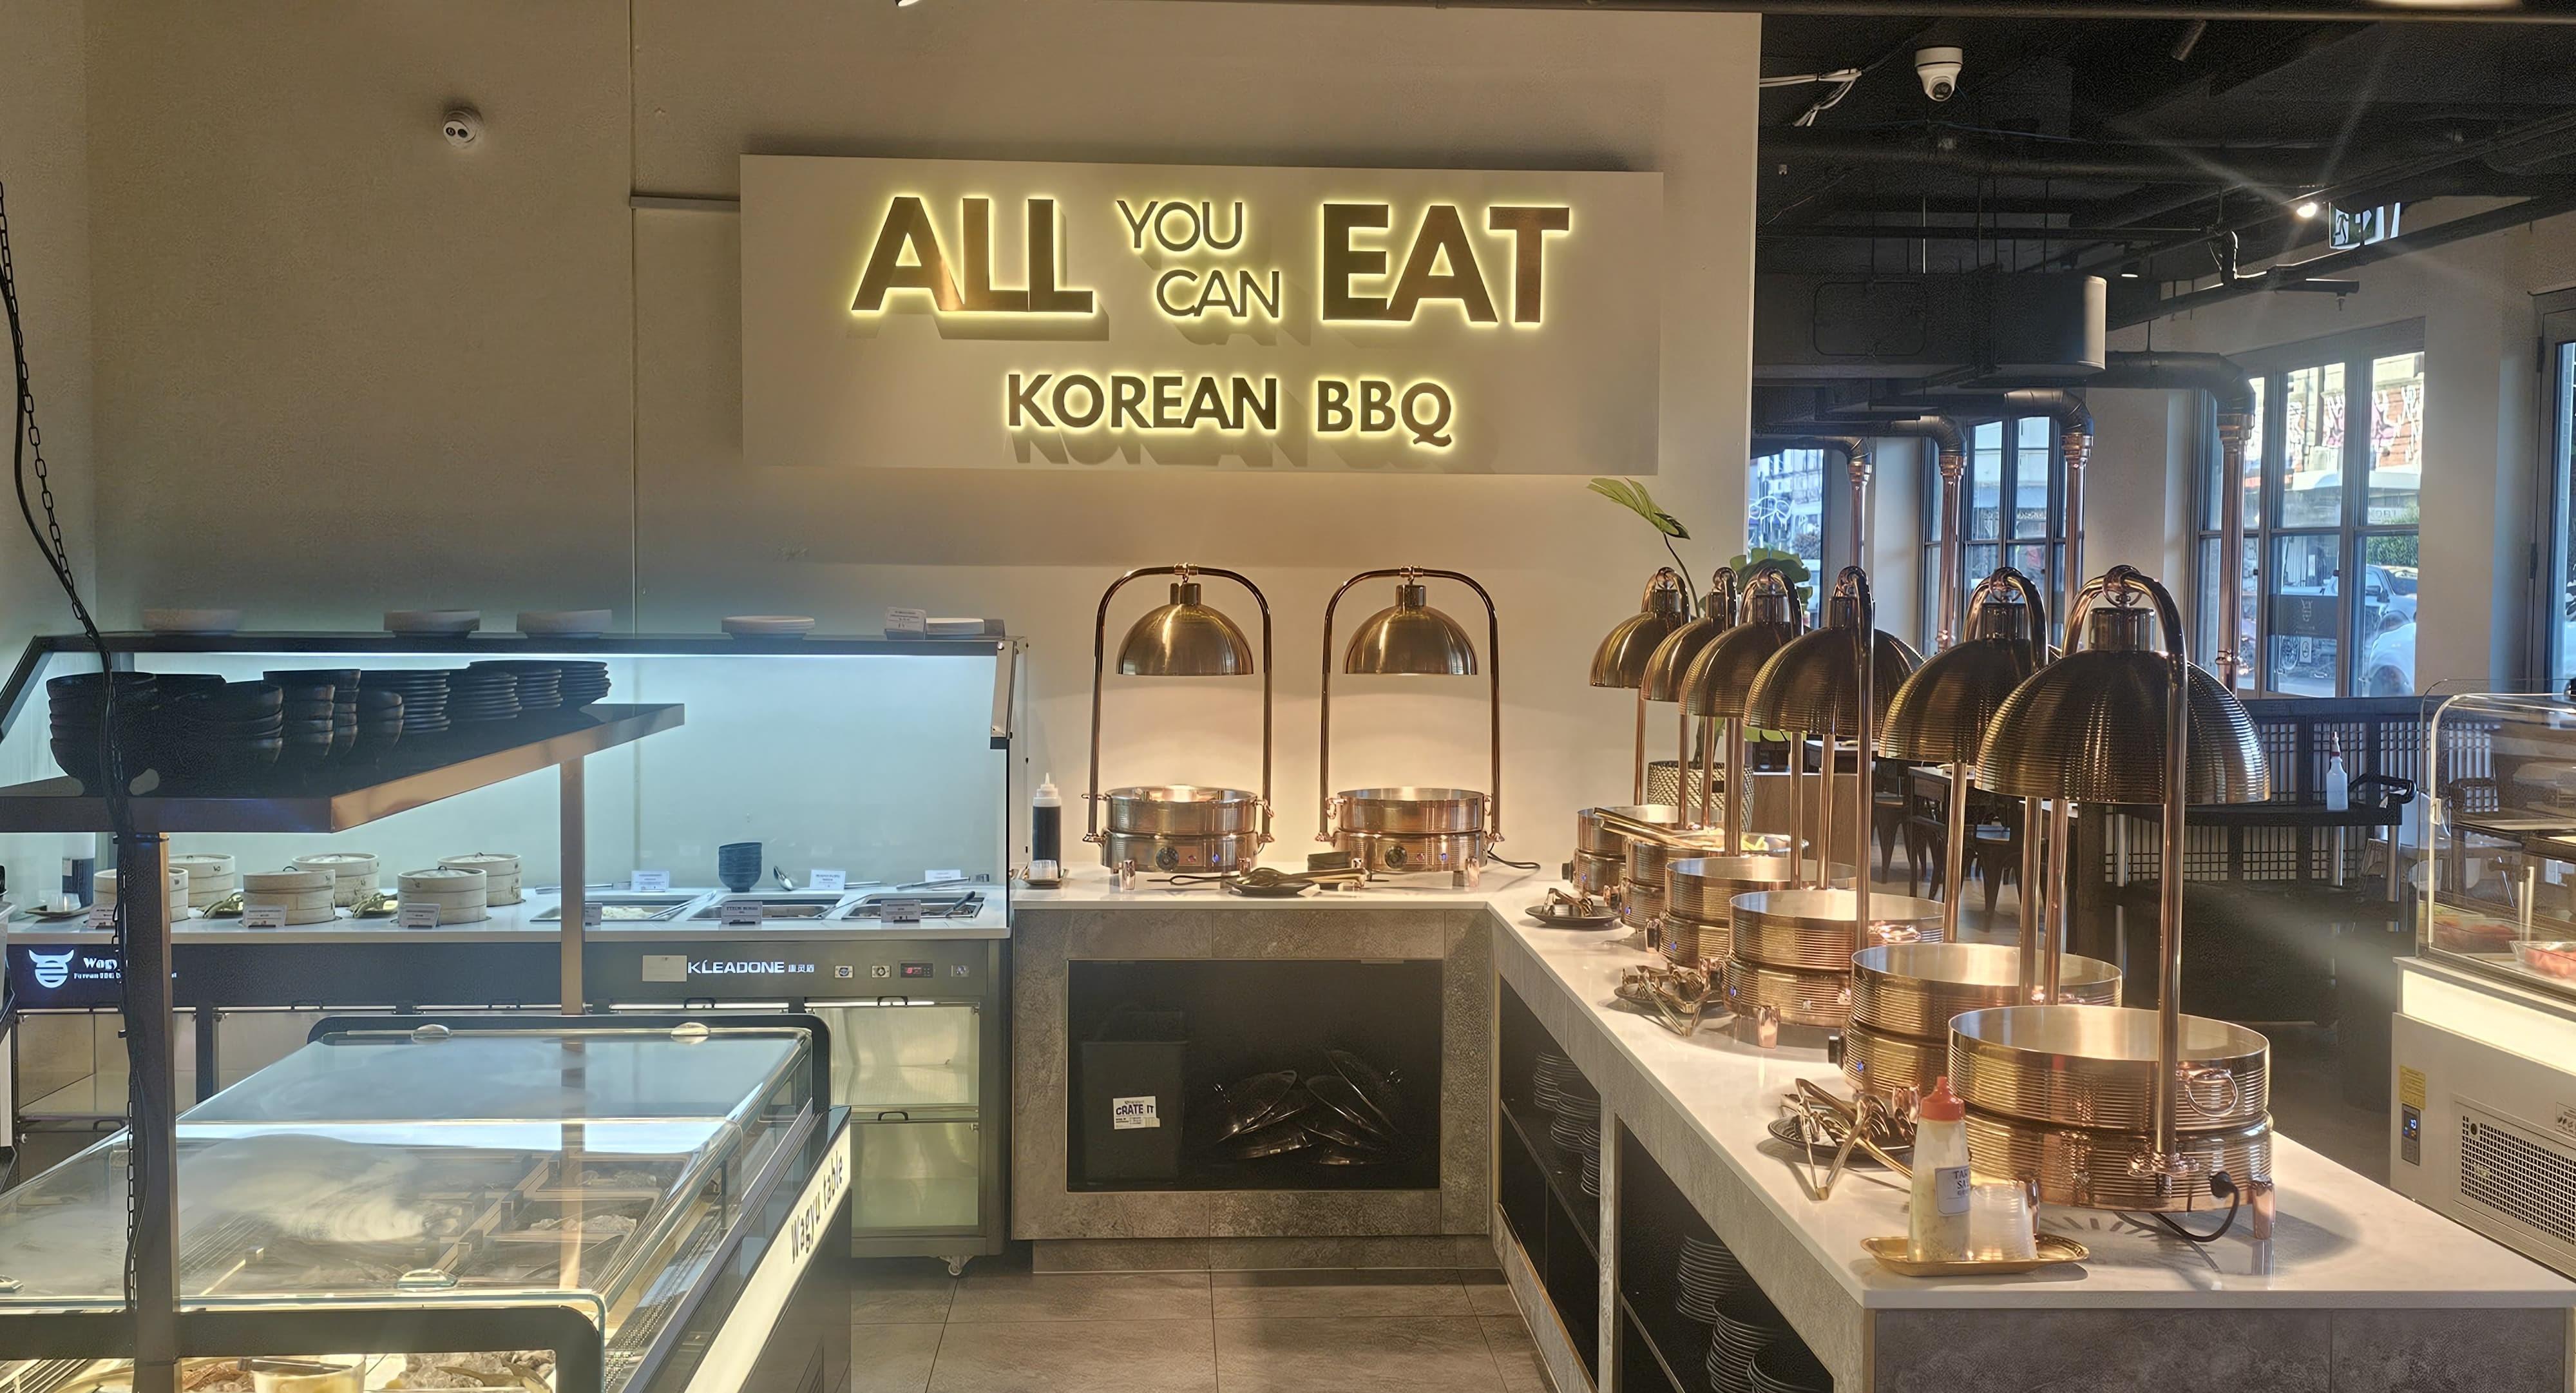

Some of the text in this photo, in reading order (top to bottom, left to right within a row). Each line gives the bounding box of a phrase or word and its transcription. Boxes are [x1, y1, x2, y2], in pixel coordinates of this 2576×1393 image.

[852, 197, 1570, 323] ALL YOU CAN EAT
[1007, 374, 1452, 447] KOREAN BBQ
[1116, 1104, 1154, 1115] CRATE IT
[791, 1150, 843, 1263] Wagyu table
